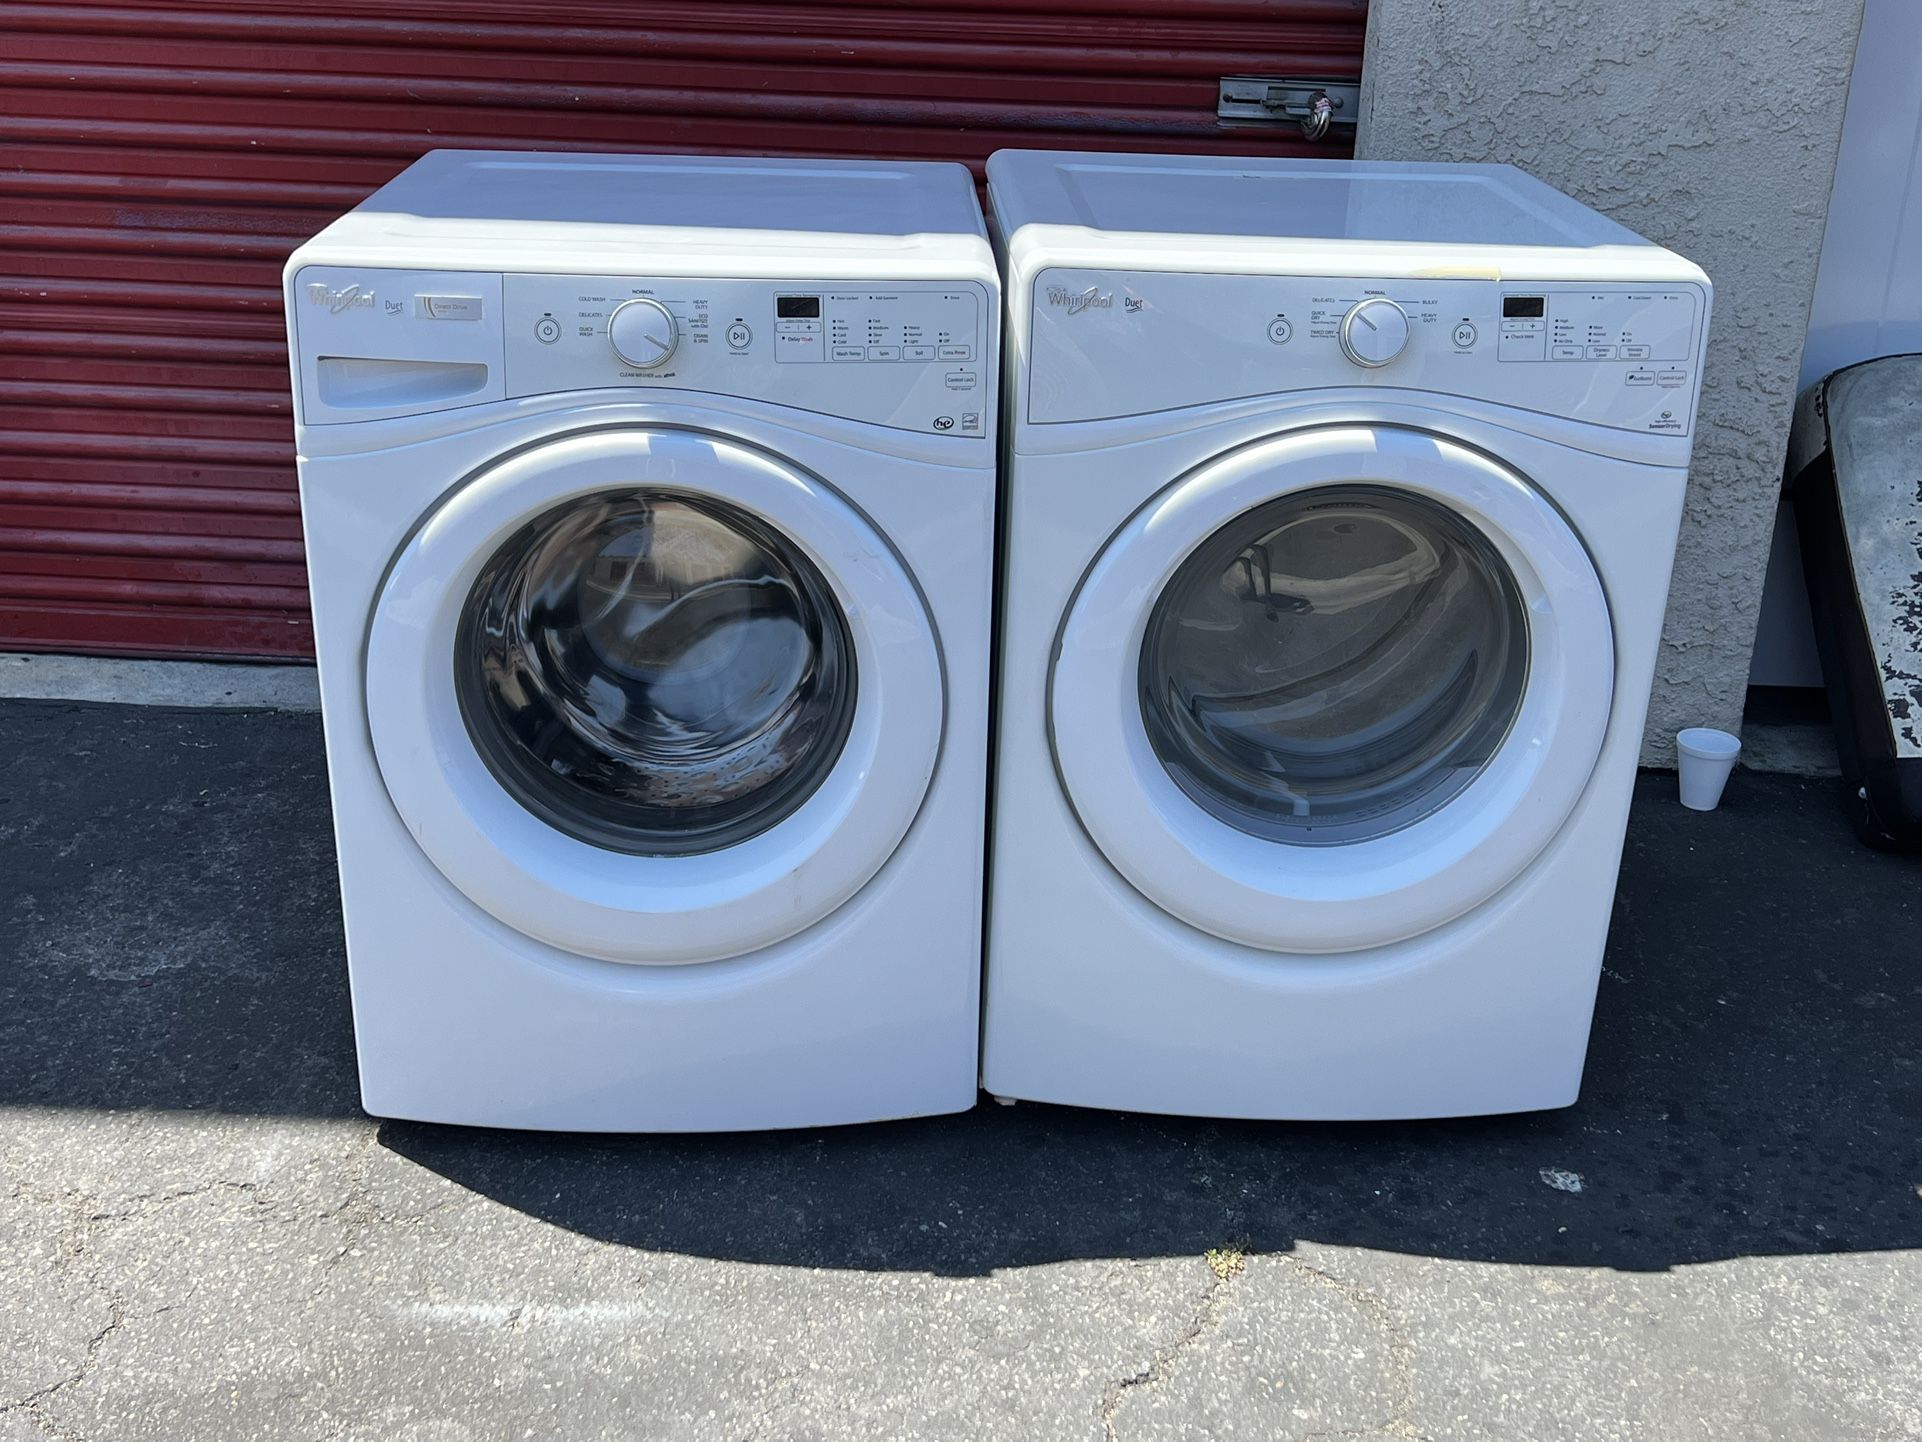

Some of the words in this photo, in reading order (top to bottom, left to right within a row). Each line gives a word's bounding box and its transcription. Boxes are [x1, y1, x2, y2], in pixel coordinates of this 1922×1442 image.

[307, 283, 375, 313] Whirlpool
[384, 299, 403, 313] Duet
[1047, 286, 1112, 314] Whirlpool
[1124, 296, 1143, 312] Duet
